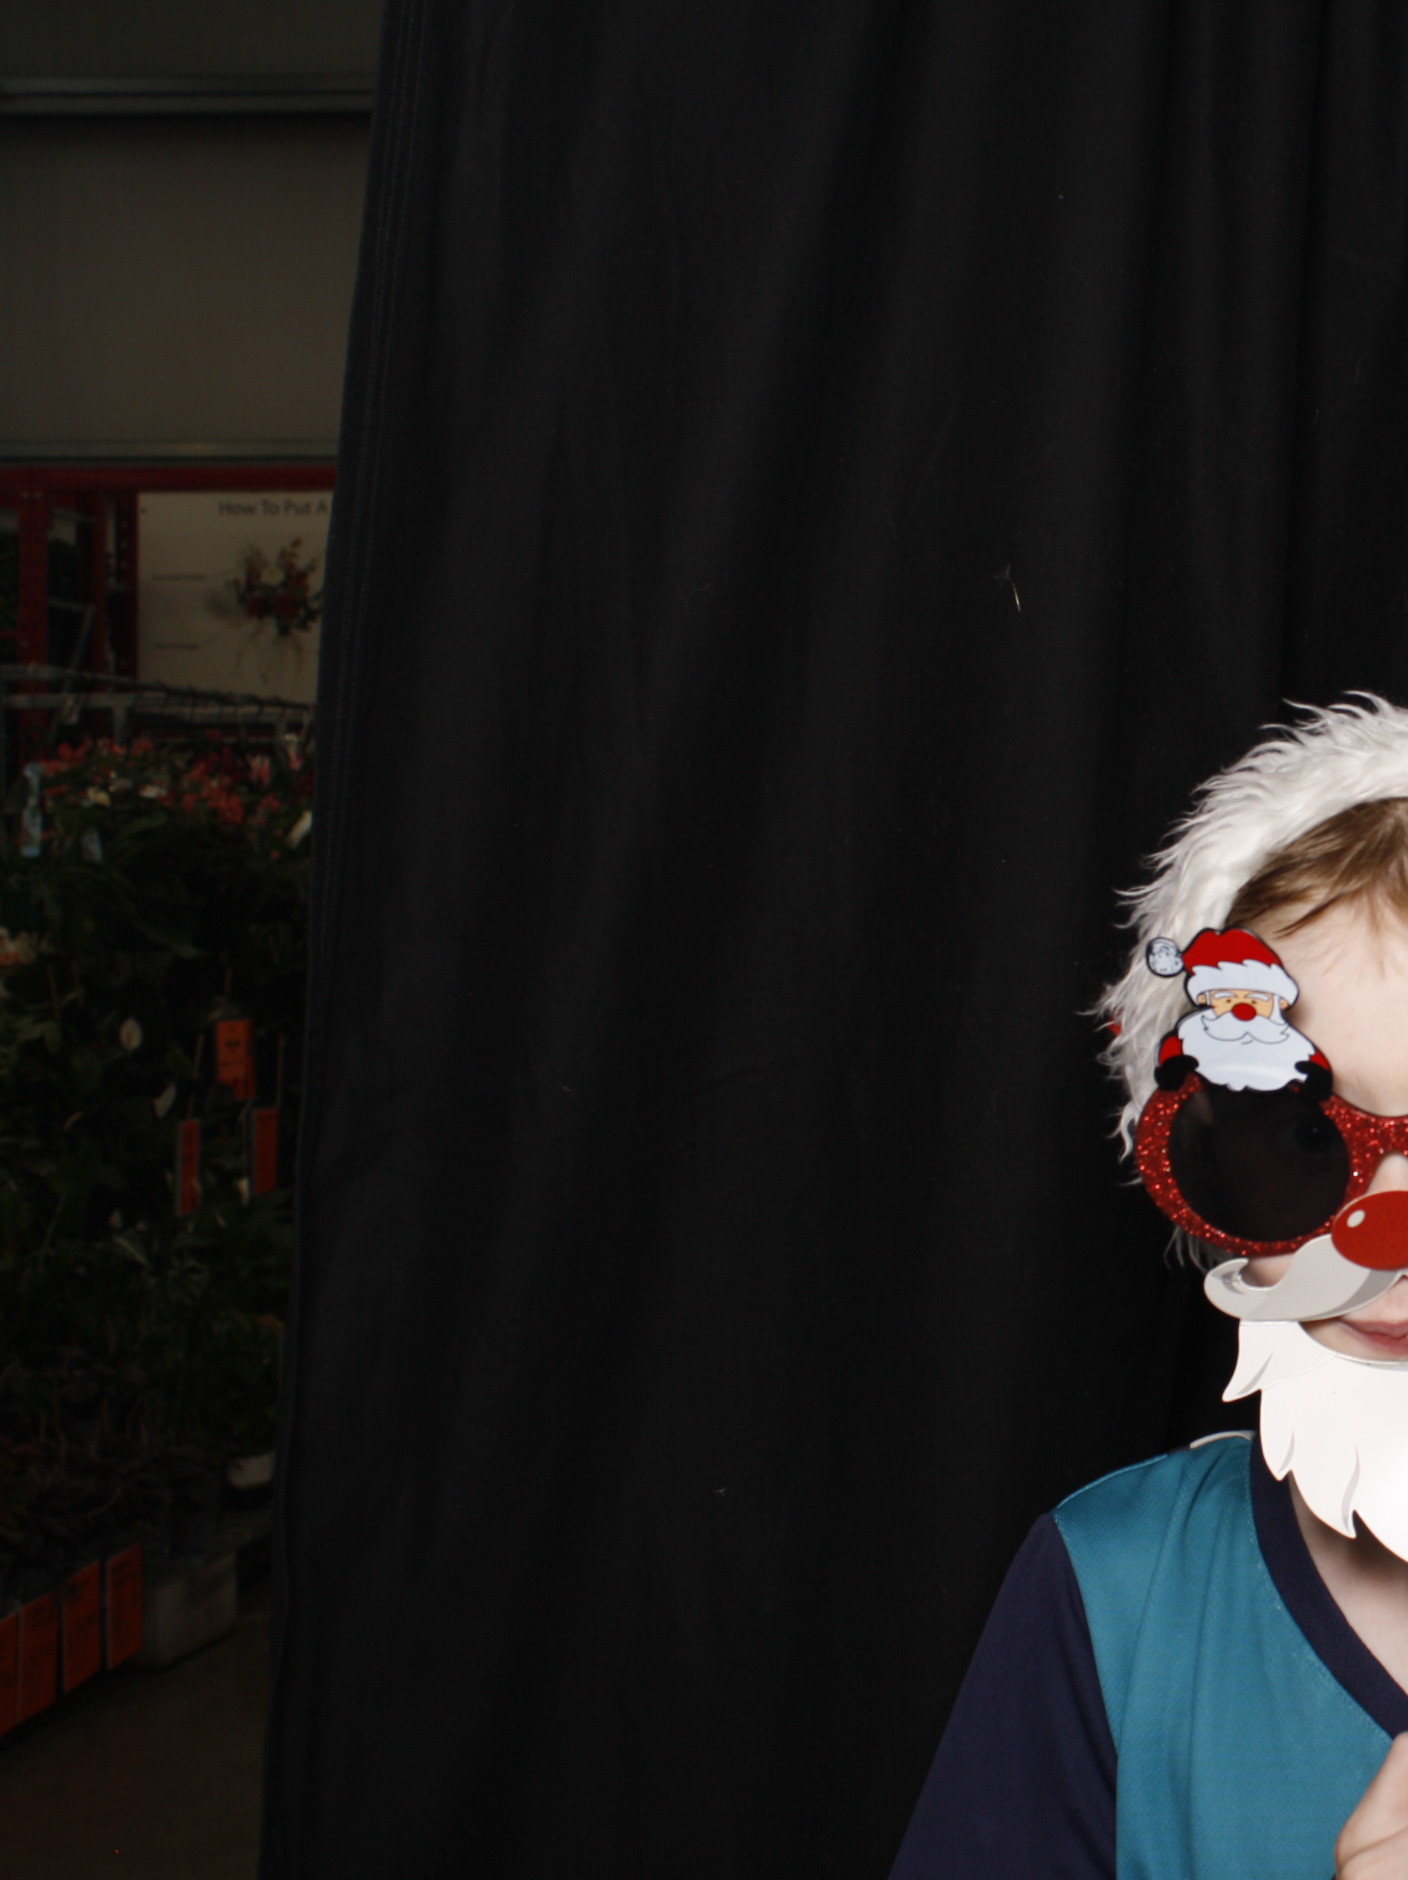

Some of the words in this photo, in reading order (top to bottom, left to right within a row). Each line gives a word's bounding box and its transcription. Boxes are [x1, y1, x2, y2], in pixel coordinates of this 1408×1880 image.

[219, 499, 256, 516] How
[260, 499, 281, 515] To
[284, 499, 311, 516] Put
